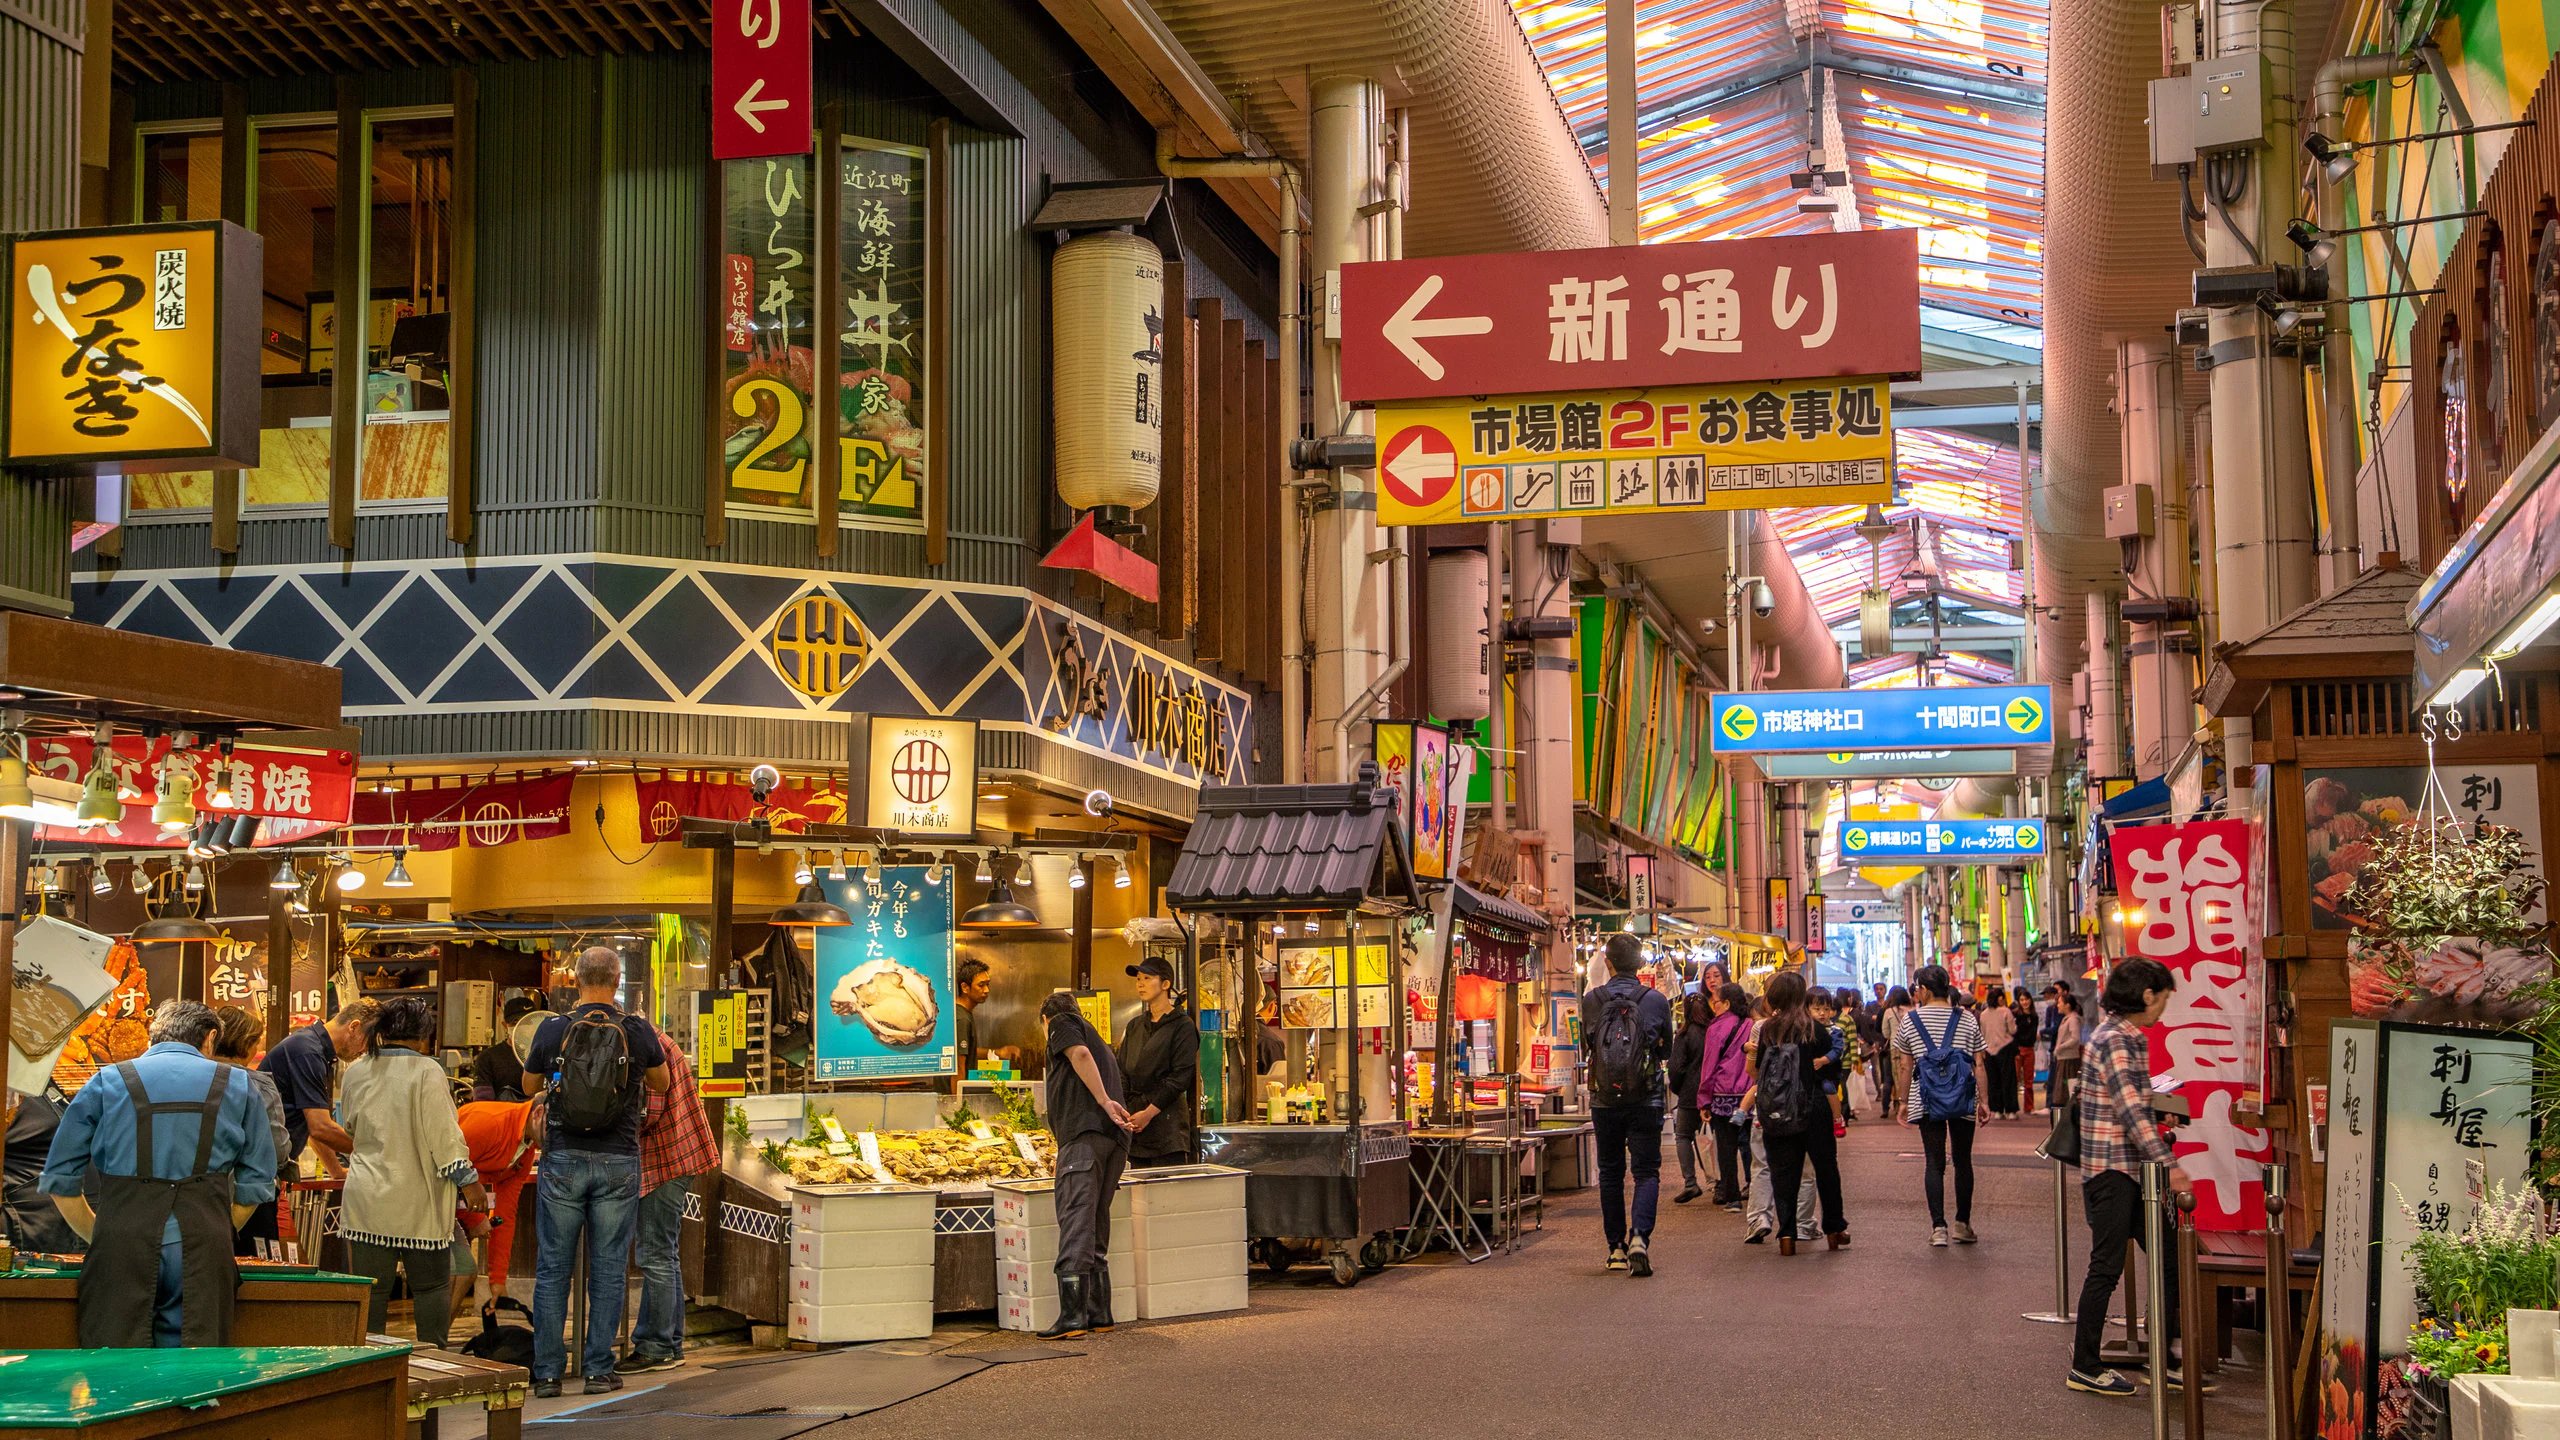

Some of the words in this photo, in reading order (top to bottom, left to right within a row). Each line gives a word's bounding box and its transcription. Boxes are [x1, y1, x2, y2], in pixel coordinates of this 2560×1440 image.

[842, 163, 911, 195] 近江町
[156, 251, 186, 327] 炭火焼
[759, 160, 803, 354] ひら井
[730, 259, 750, 347] いちば館店
[841, 198, 913, 414] 海鮮丼家
[1548, 263, 1839, 363] 新通り
[61, 255, 166, 437] うなぎ
[1470, 388, 1882, 457] 市場館2Fお食事処
[1711, 461, 1861, 489] 近江町いちば館
[1762, 709, 1864, 733] 市姫神社口
[1916, 705, 2001, 729] 十間町口
[893, 812, 949, 829] 川木商店
[1960, 837, 2015, 850] パーキング口
[892, 880, 909, 938] 今年も
[209, 927, 257, 1010] 加能
[717, 1013, 729, 1048] のど黒
[2429, 1042, 2498, 1149] 刺身屋
